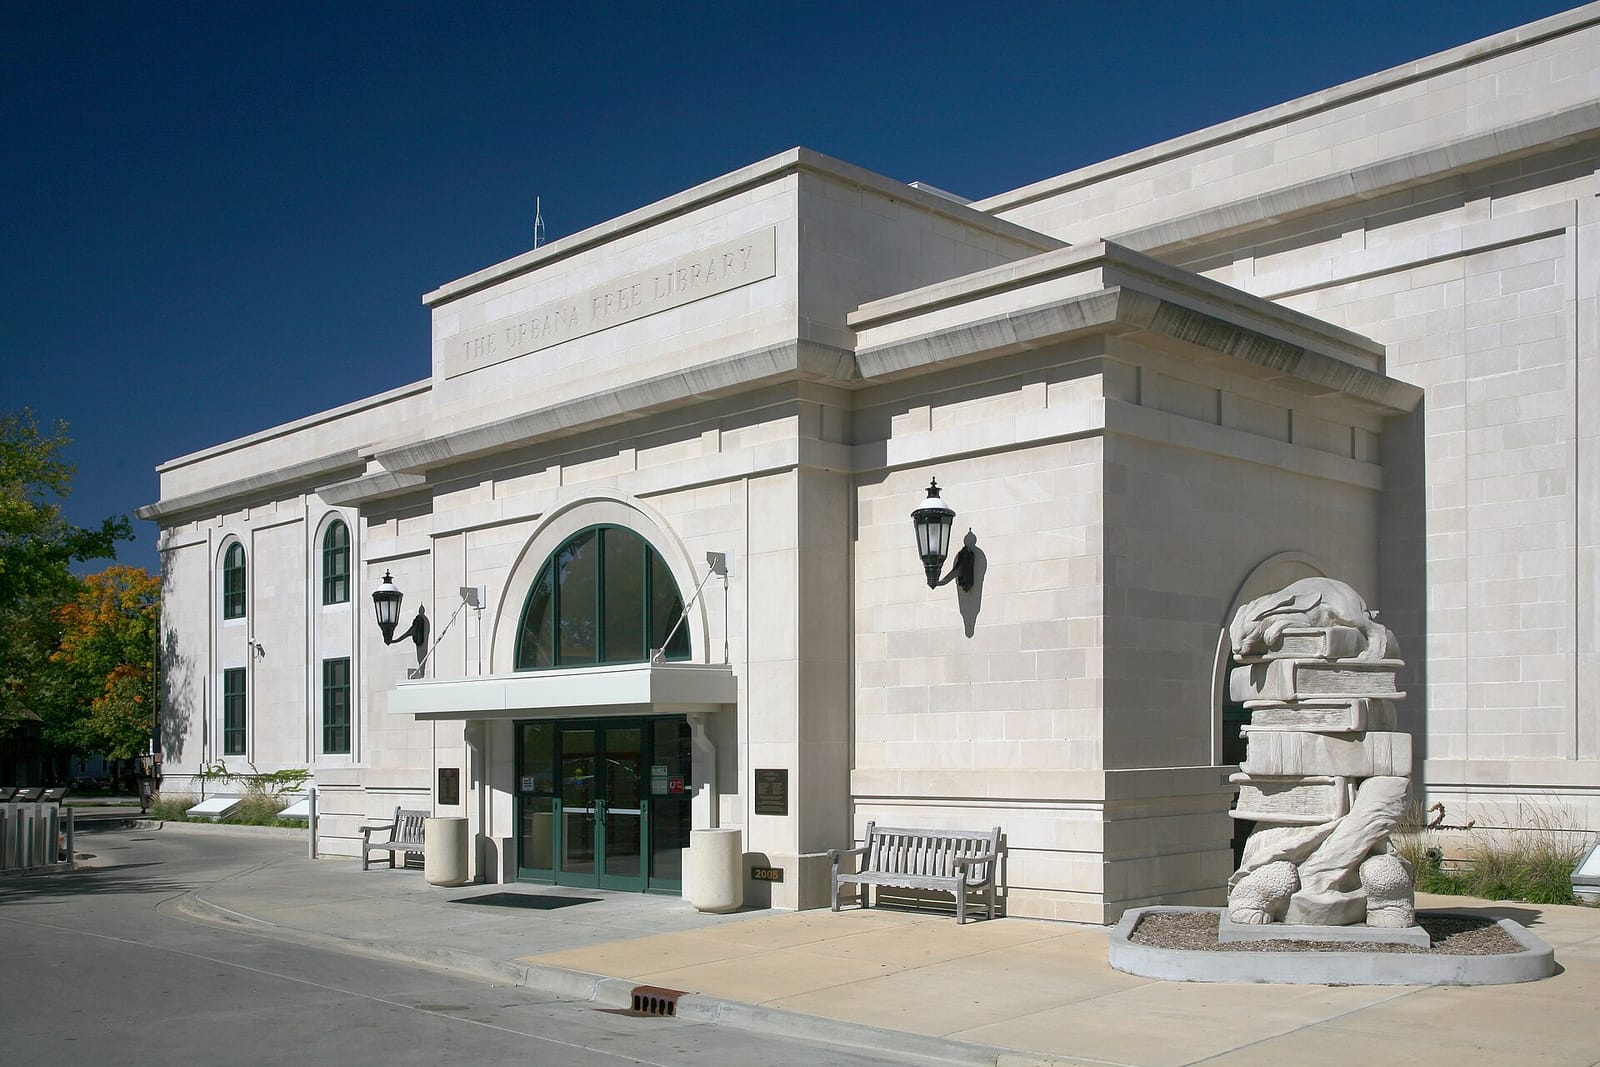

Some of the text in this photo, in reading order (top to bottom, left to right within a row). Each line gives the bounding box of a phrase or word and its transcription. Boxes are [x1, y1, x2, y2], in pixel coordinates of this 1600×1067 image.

[463, 245, 753, 361] THE URBANA FREE LIBRARY
[755, 869, 778, 879] 2005
